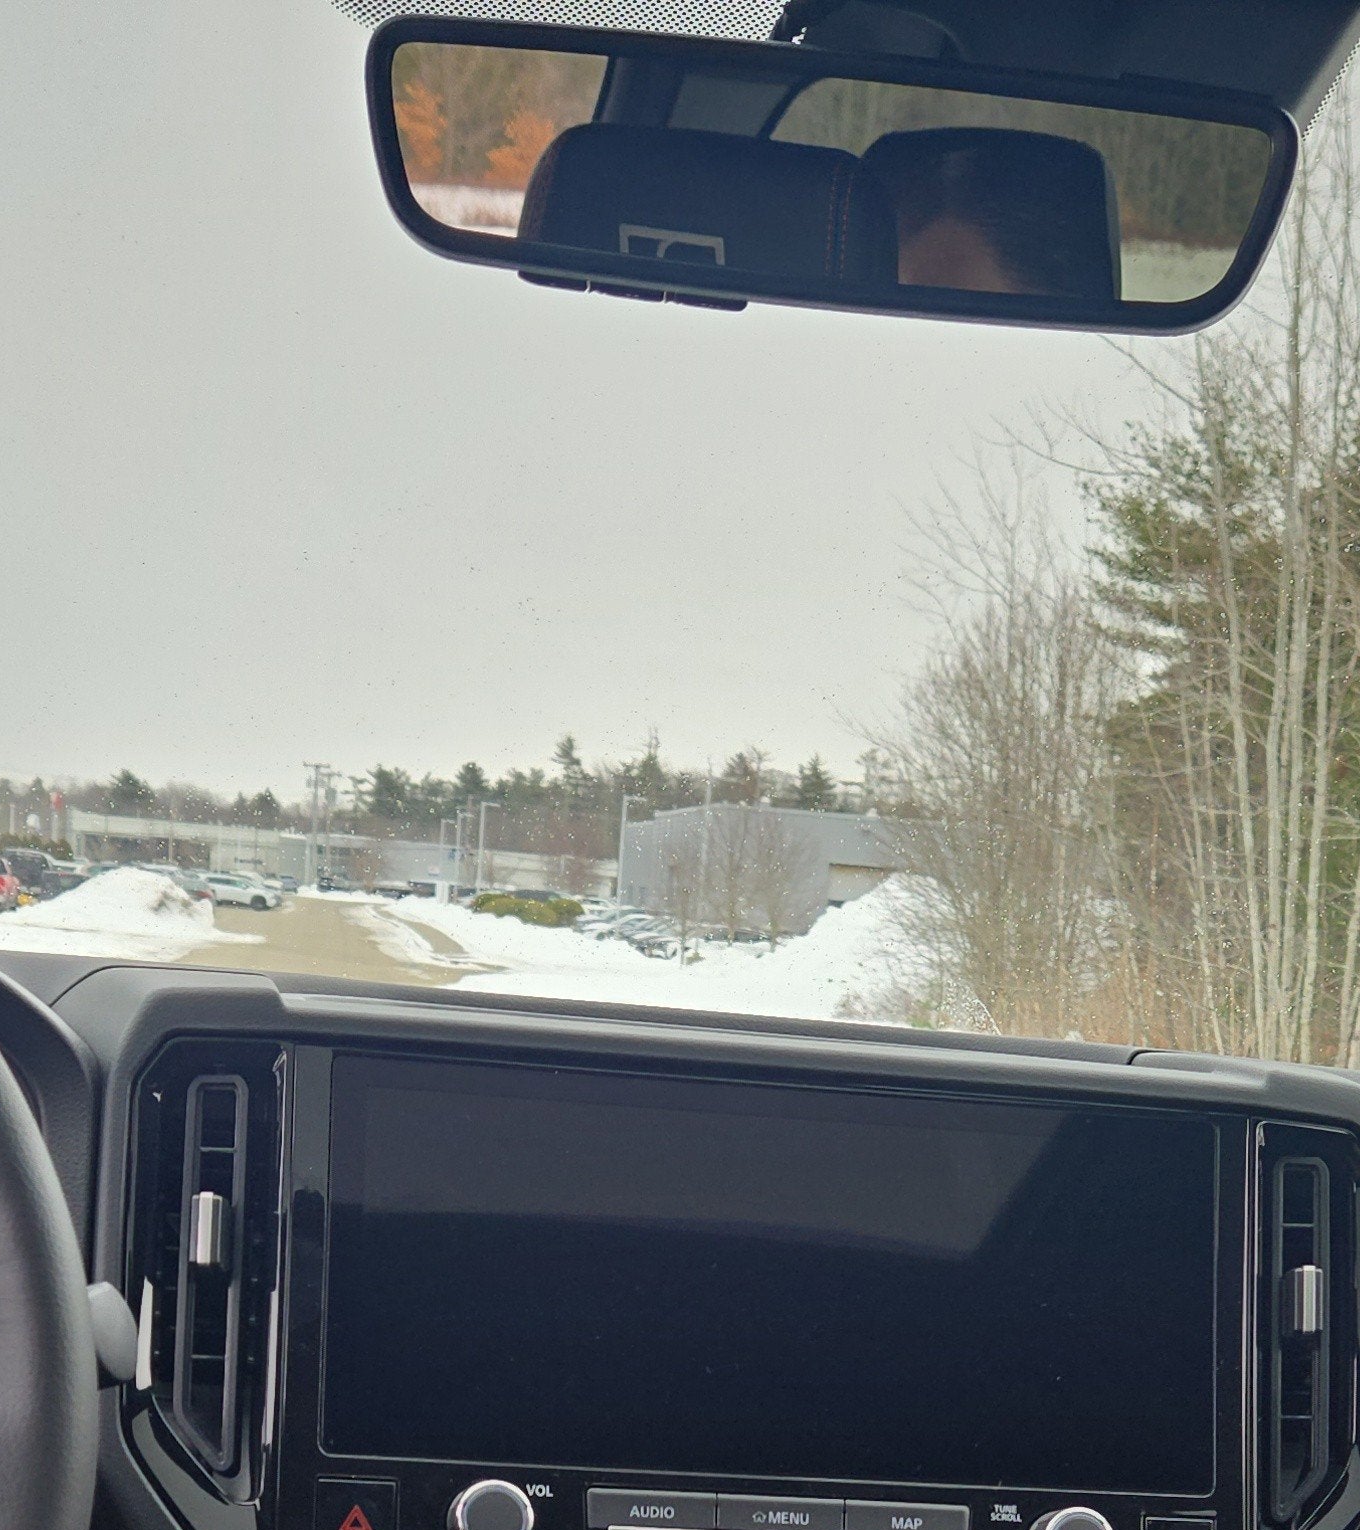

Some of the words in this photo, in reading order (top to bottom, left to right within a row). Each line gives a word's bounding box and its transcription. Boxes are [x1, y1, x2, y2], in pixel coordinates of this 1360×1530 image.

[525, 1484, 554, 1498] VOL
[629, 1504, 676, 1520] AUDIO
[993, 1504, 1018, 1514] TUNE
[767, 1510, 810, 1526] MENU
[890, 1516, 924, 1530] MAP
[990, 1513, 1023, 1523] SCROLL
